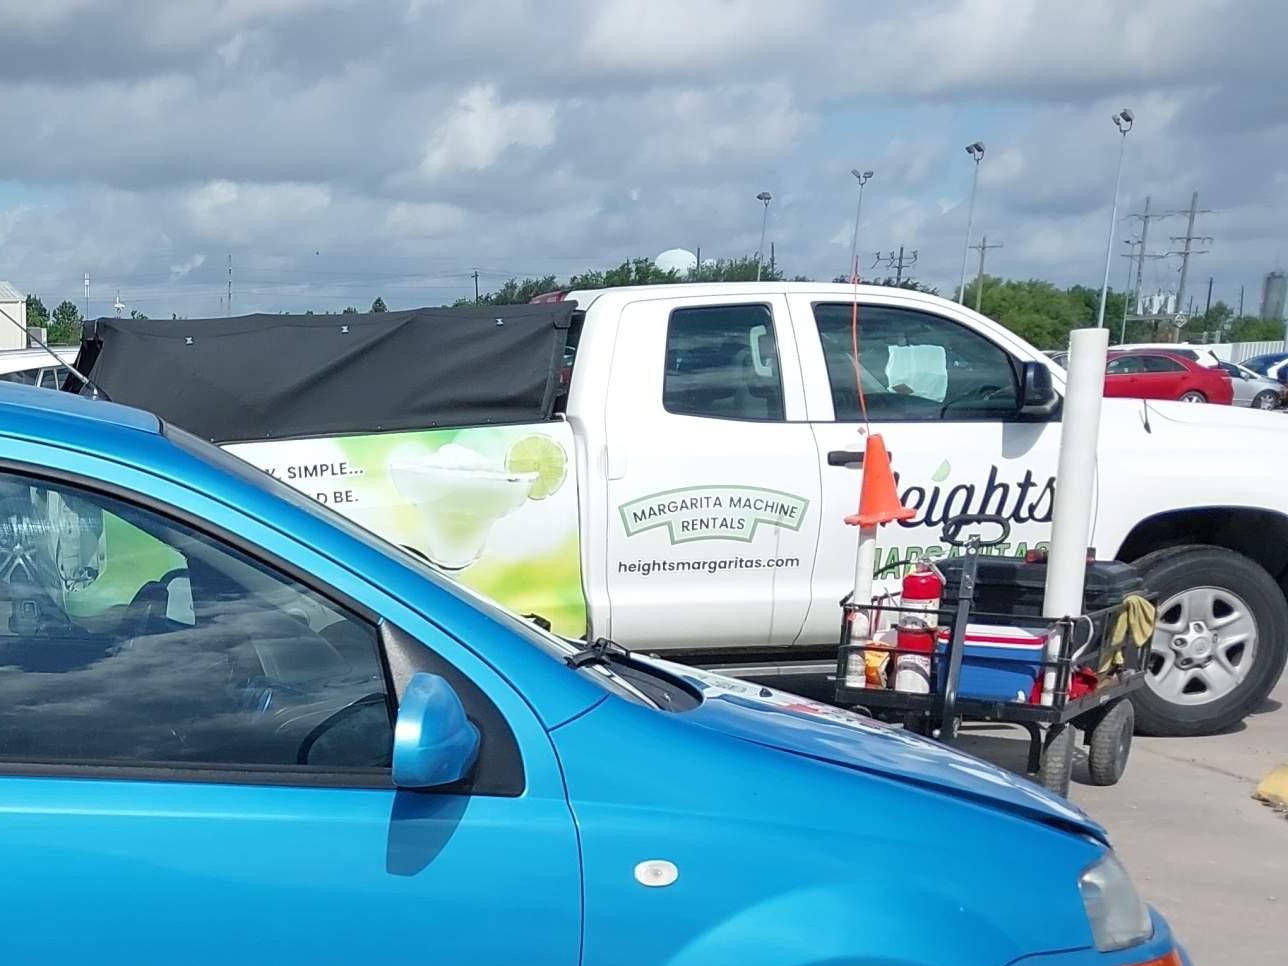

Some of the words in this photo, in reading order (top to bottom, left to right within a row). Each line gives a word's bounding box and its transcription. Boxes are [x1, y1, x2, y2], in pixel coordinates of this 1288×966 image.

[287, 462, 365, 480] SIMPLE...
[333, 490, 360, 504] BE.
[880, 464, 1056, 540] eights
[632, 496, 723, 524] MARGARITA
[728, 496, 798, 519] MACHINE
[681, 517, 746, 533] RENTALS
[617, 556, 800, 575] heightsmargaritas.com
